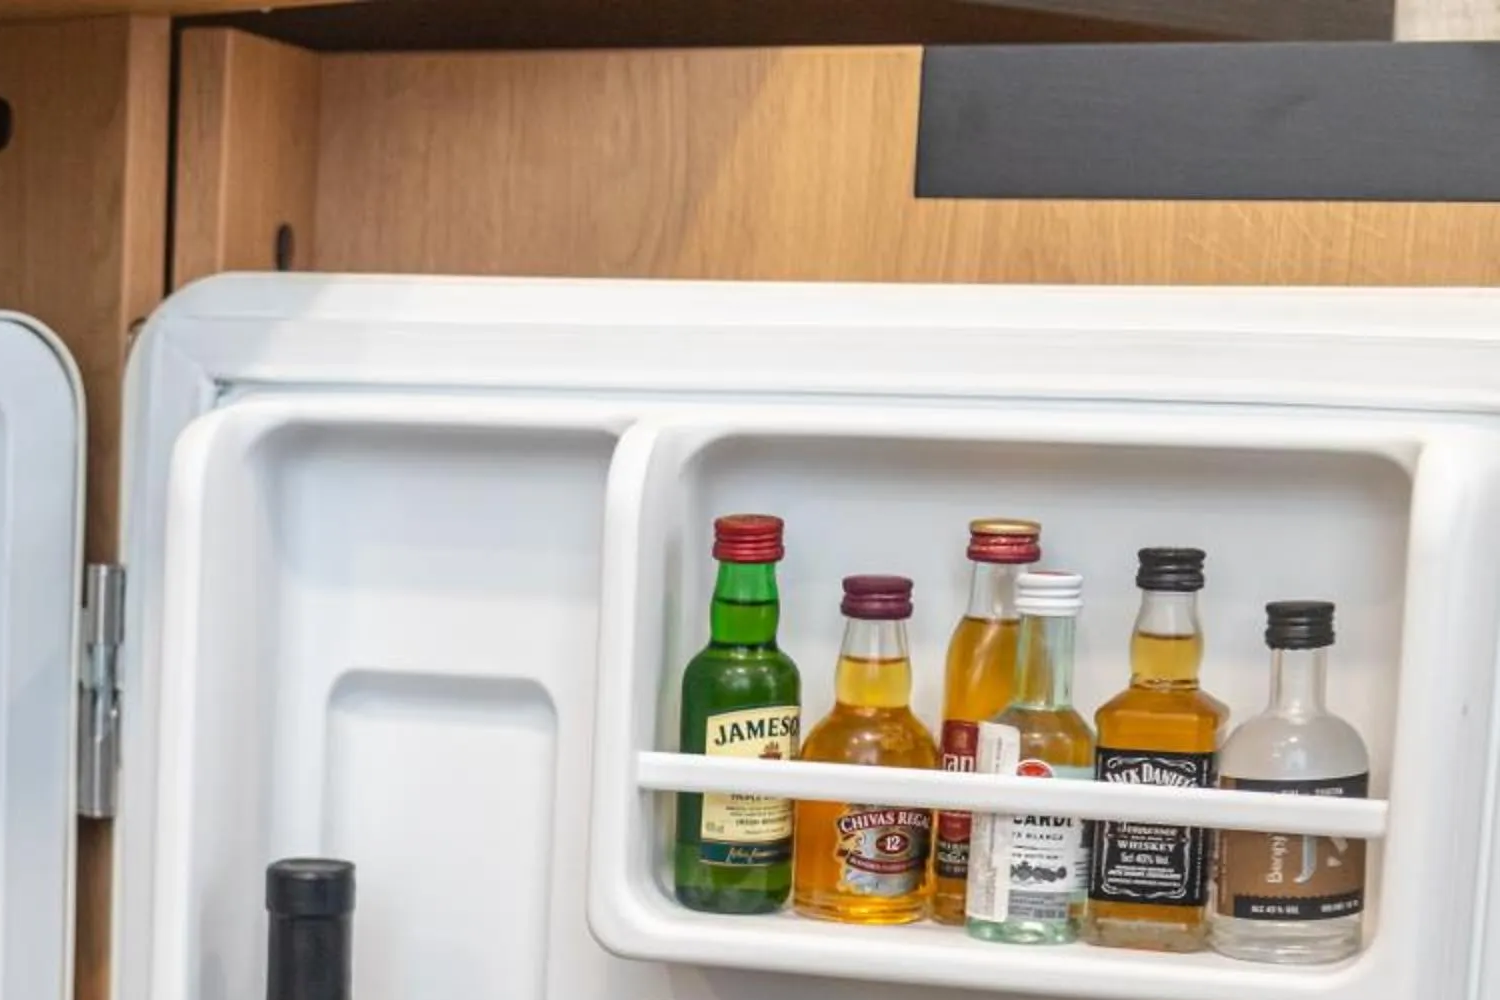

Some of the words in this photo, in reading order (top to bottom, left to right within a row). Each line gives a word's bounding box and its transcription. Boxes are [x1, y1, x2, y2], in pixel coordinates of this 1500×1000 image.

[714, 716, 799, 746] JAMESO
[841, 812, 895, 833] CHIVAS
[897, 811, 930, 829] REGA
[885, 835, 901, 852] 12
